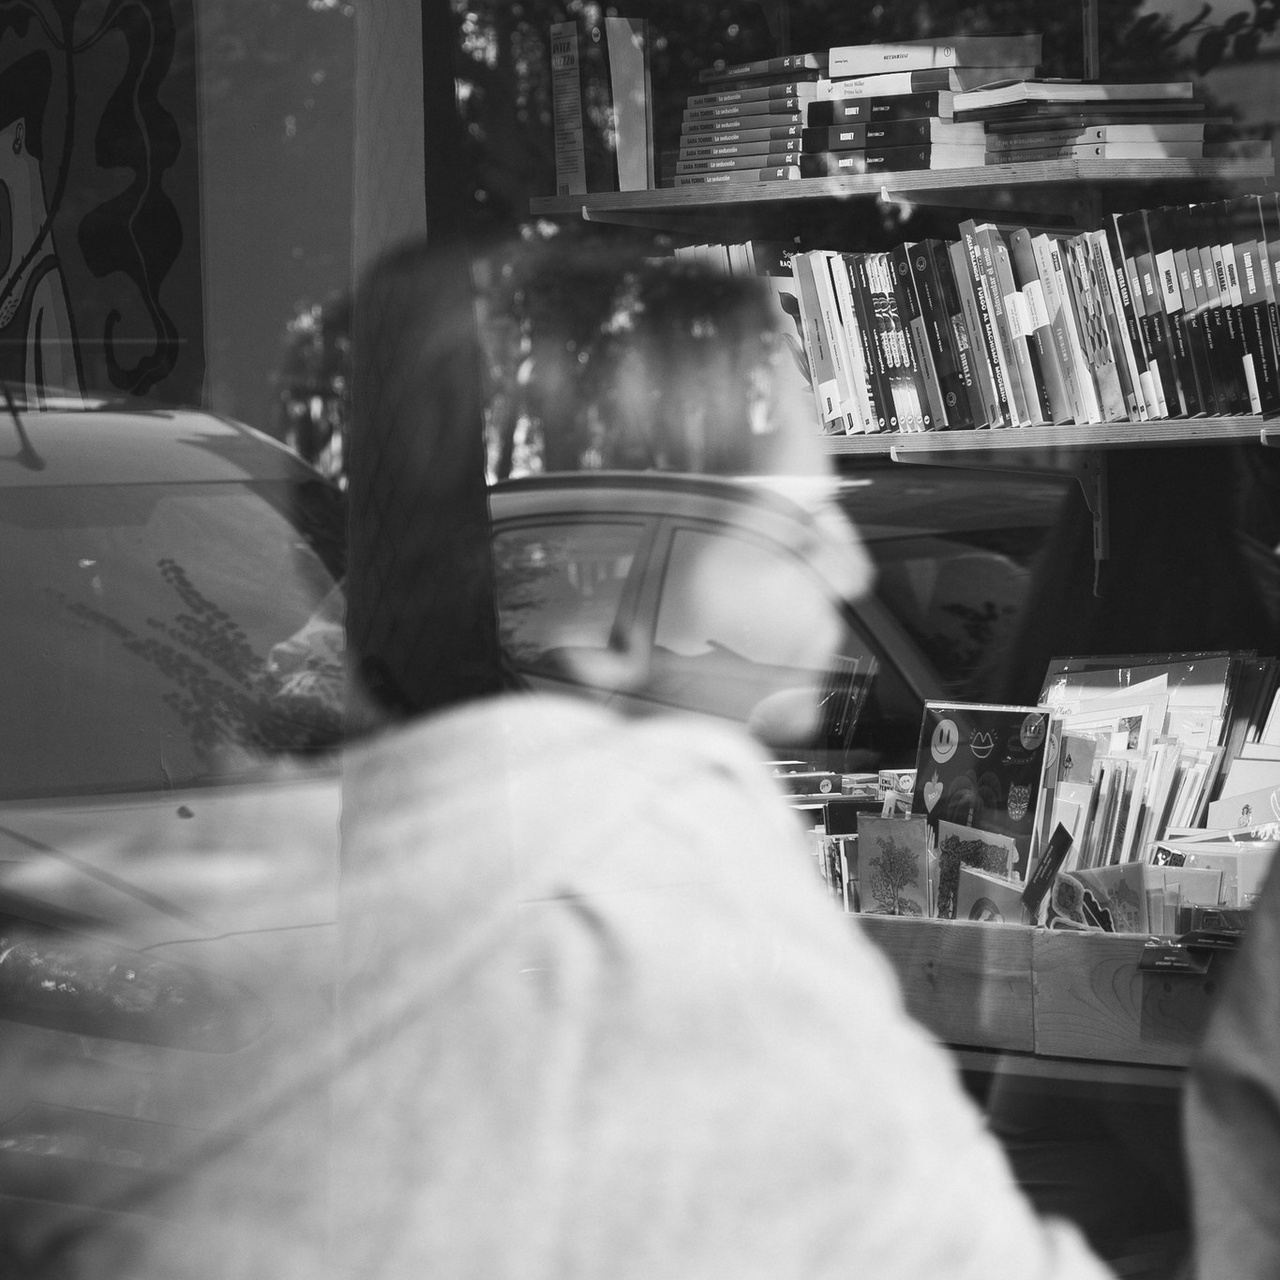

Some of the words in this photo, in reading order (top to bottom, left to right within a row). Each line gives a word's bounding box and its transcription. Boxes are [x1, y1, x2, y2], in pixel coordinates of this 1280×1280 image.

[553, 43, 571, 54] INTER
[1165, 269, 1175, 294] MORENO
[1193, 269, 1203, 289] PAZOS
[1246, 268, 1257, 295] ANTUNES
[976, 287, 988, 311] FUEGO
[984, 324, 999, 365] MACHISMO
[994, 366, 1007, 403] MODERNO
